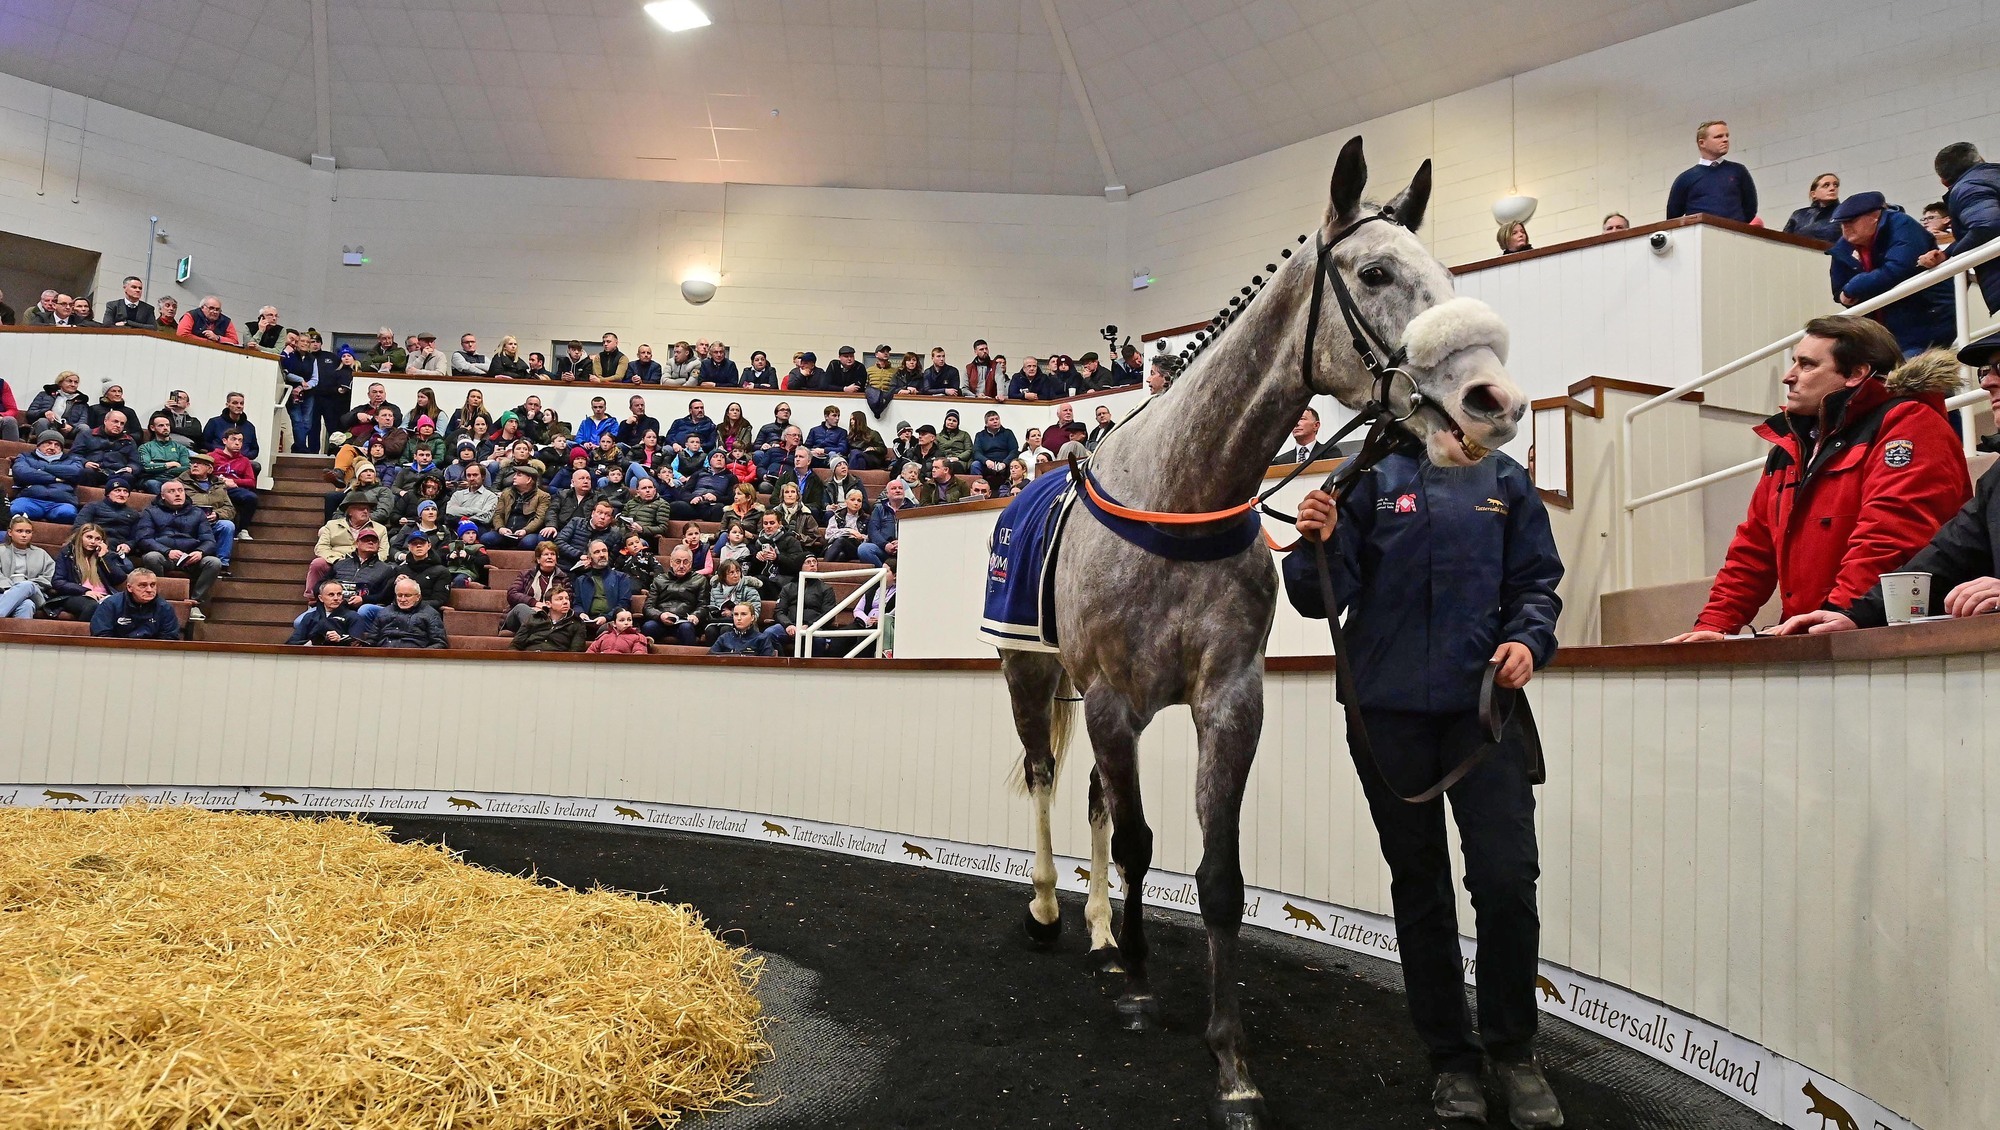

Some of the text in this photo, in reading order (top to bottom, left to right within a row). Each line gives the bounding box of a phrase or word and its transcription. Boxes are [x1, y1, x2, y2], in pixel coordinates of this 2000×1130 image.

[183, 791, 240, 806] Ireland
[302, 793, 429, 810] Tattersalls Ireland
[485, 798, 598, 818] Tattersalls Ireland
[647, 808, 748, 833] Tattersalls Ireland
[792, 825, 888, 855] Tattersalls Ireland
[935, 847, 1034, 879] Tattersalls Irela
[1118, 880, 1198, 906] tersalls
[1329, 913, 1399, 952] Tattersa
[1568, 983, 1760, 1096] Tattersalls Ireland
